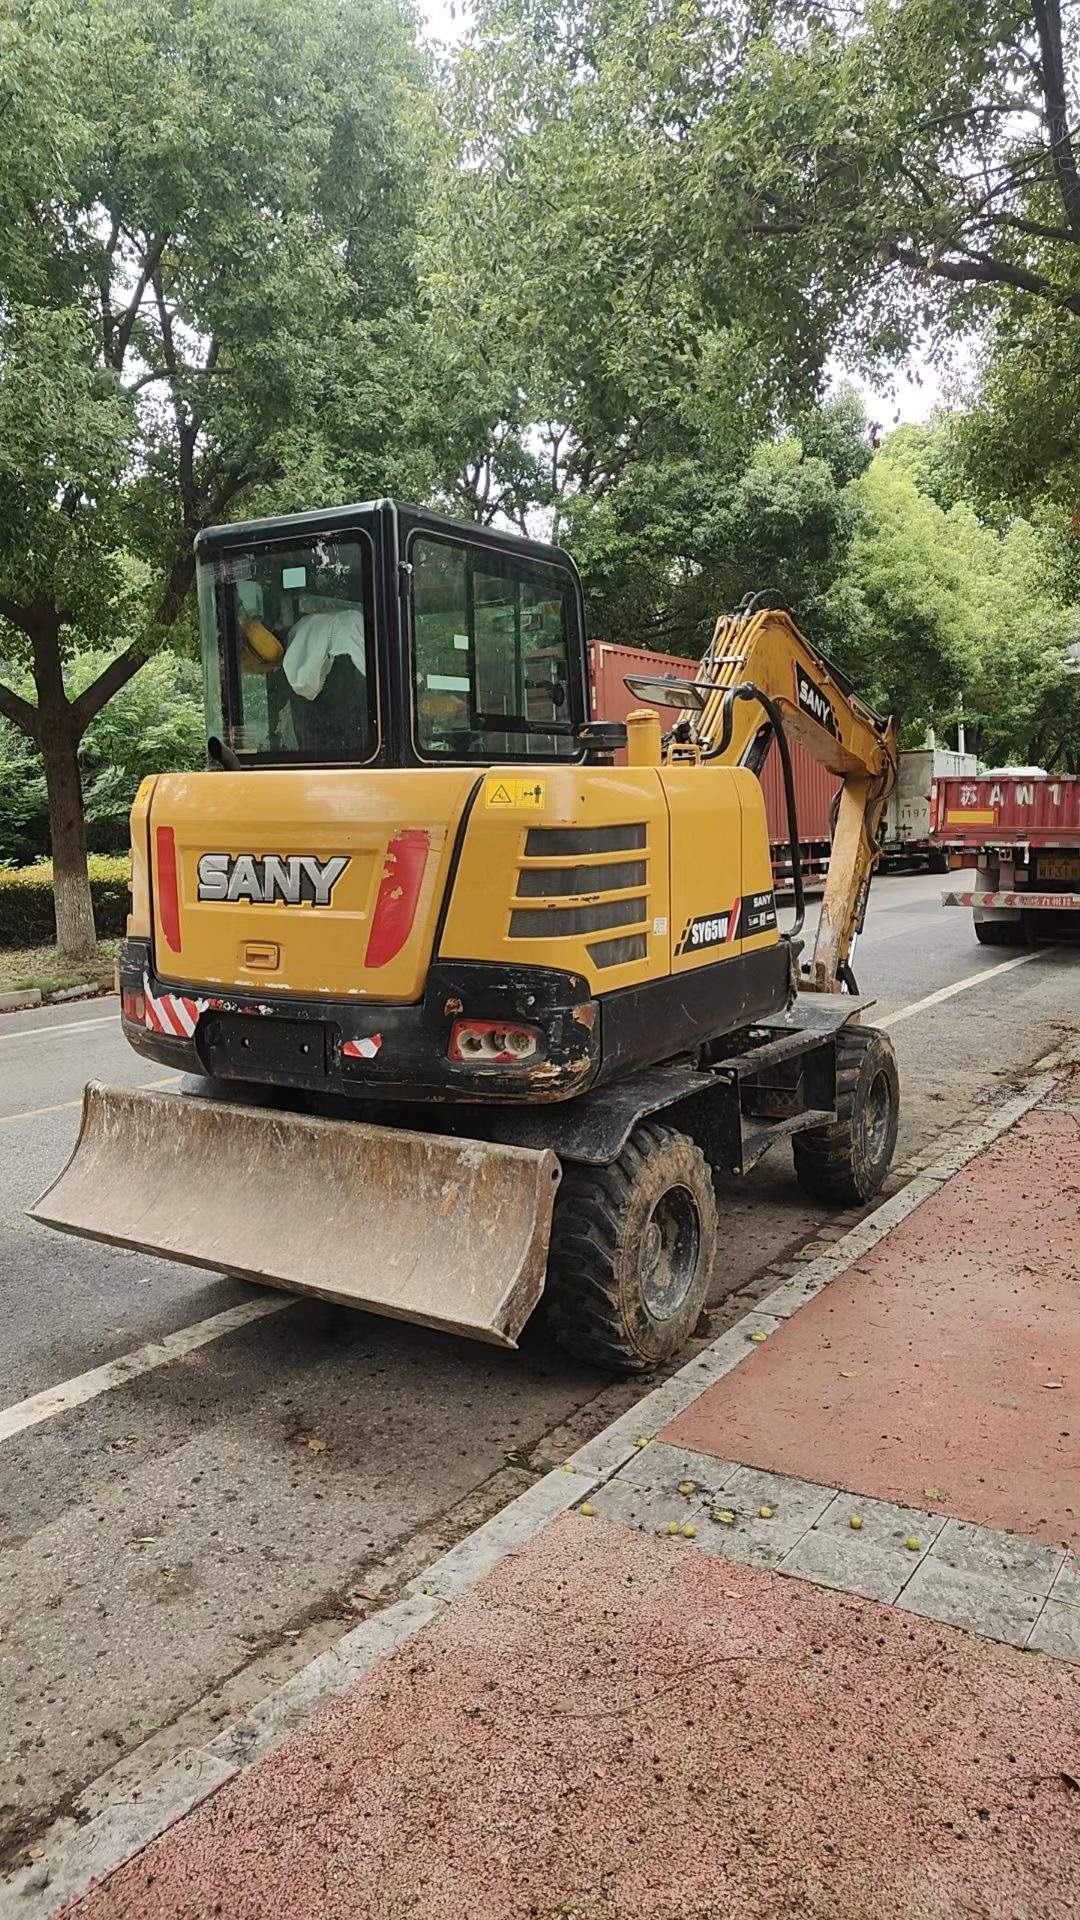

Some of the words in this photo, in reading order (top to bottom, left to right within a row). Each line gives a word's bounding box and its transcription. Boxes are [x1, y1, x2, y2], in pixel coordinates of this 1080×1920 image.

[800, 680, 830, 725] SANY
[199, 854, 351, 905] SANY
[753, 894, 772, 908] SANY
[691, 917, 729, 945] SY65W
